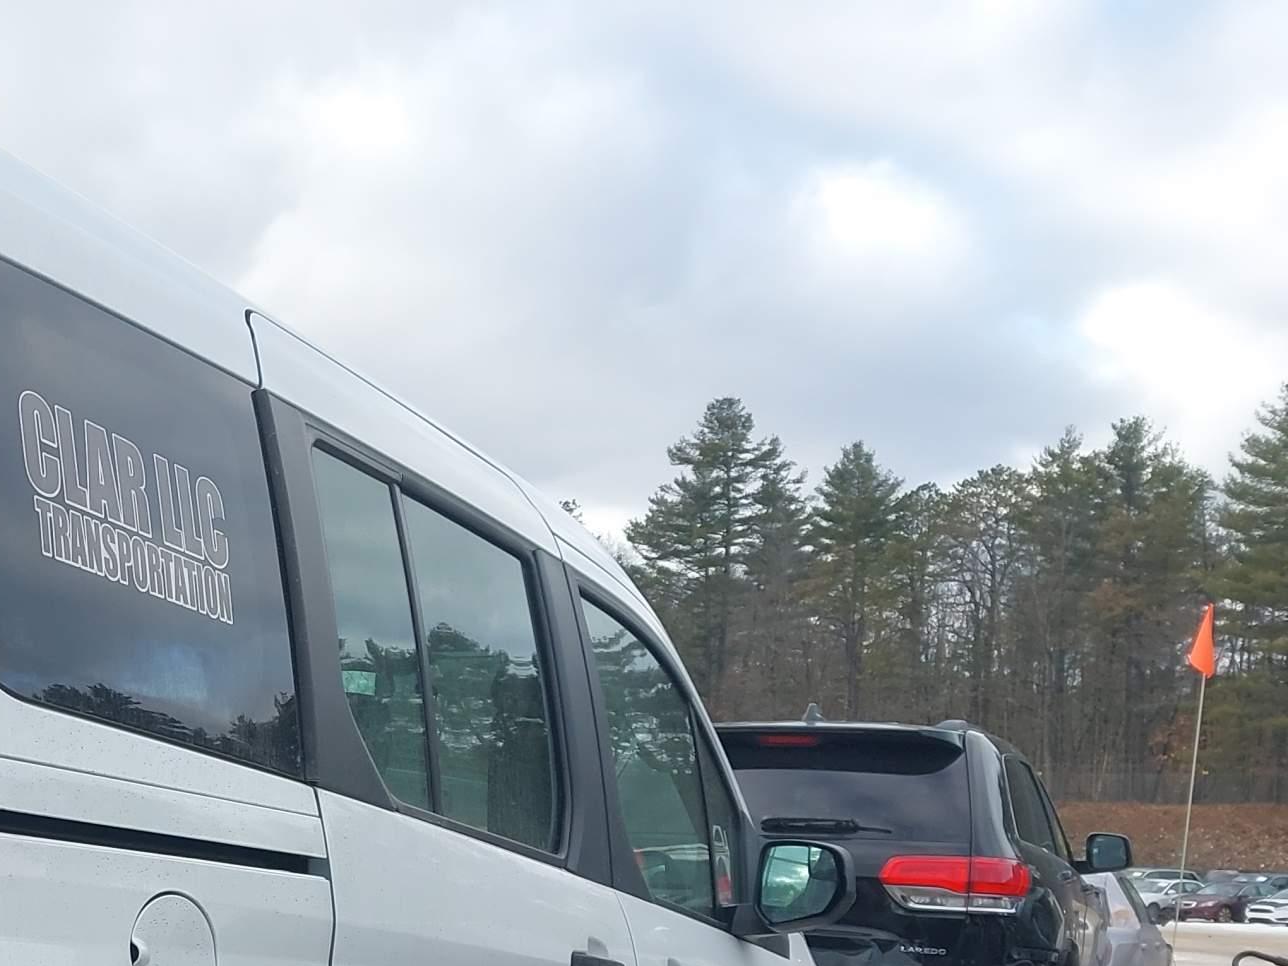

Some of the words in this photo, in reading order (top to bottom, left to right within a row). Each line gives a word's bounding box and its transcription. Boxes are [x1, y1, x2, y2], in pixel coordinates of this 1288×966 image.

[18, 390, 152, 539] CLAR
[153, 453, 230, 570] LLC
[33, 495, 234, 624] TRANSPORTATION
[900, 945, 947, 955] LAREDO
